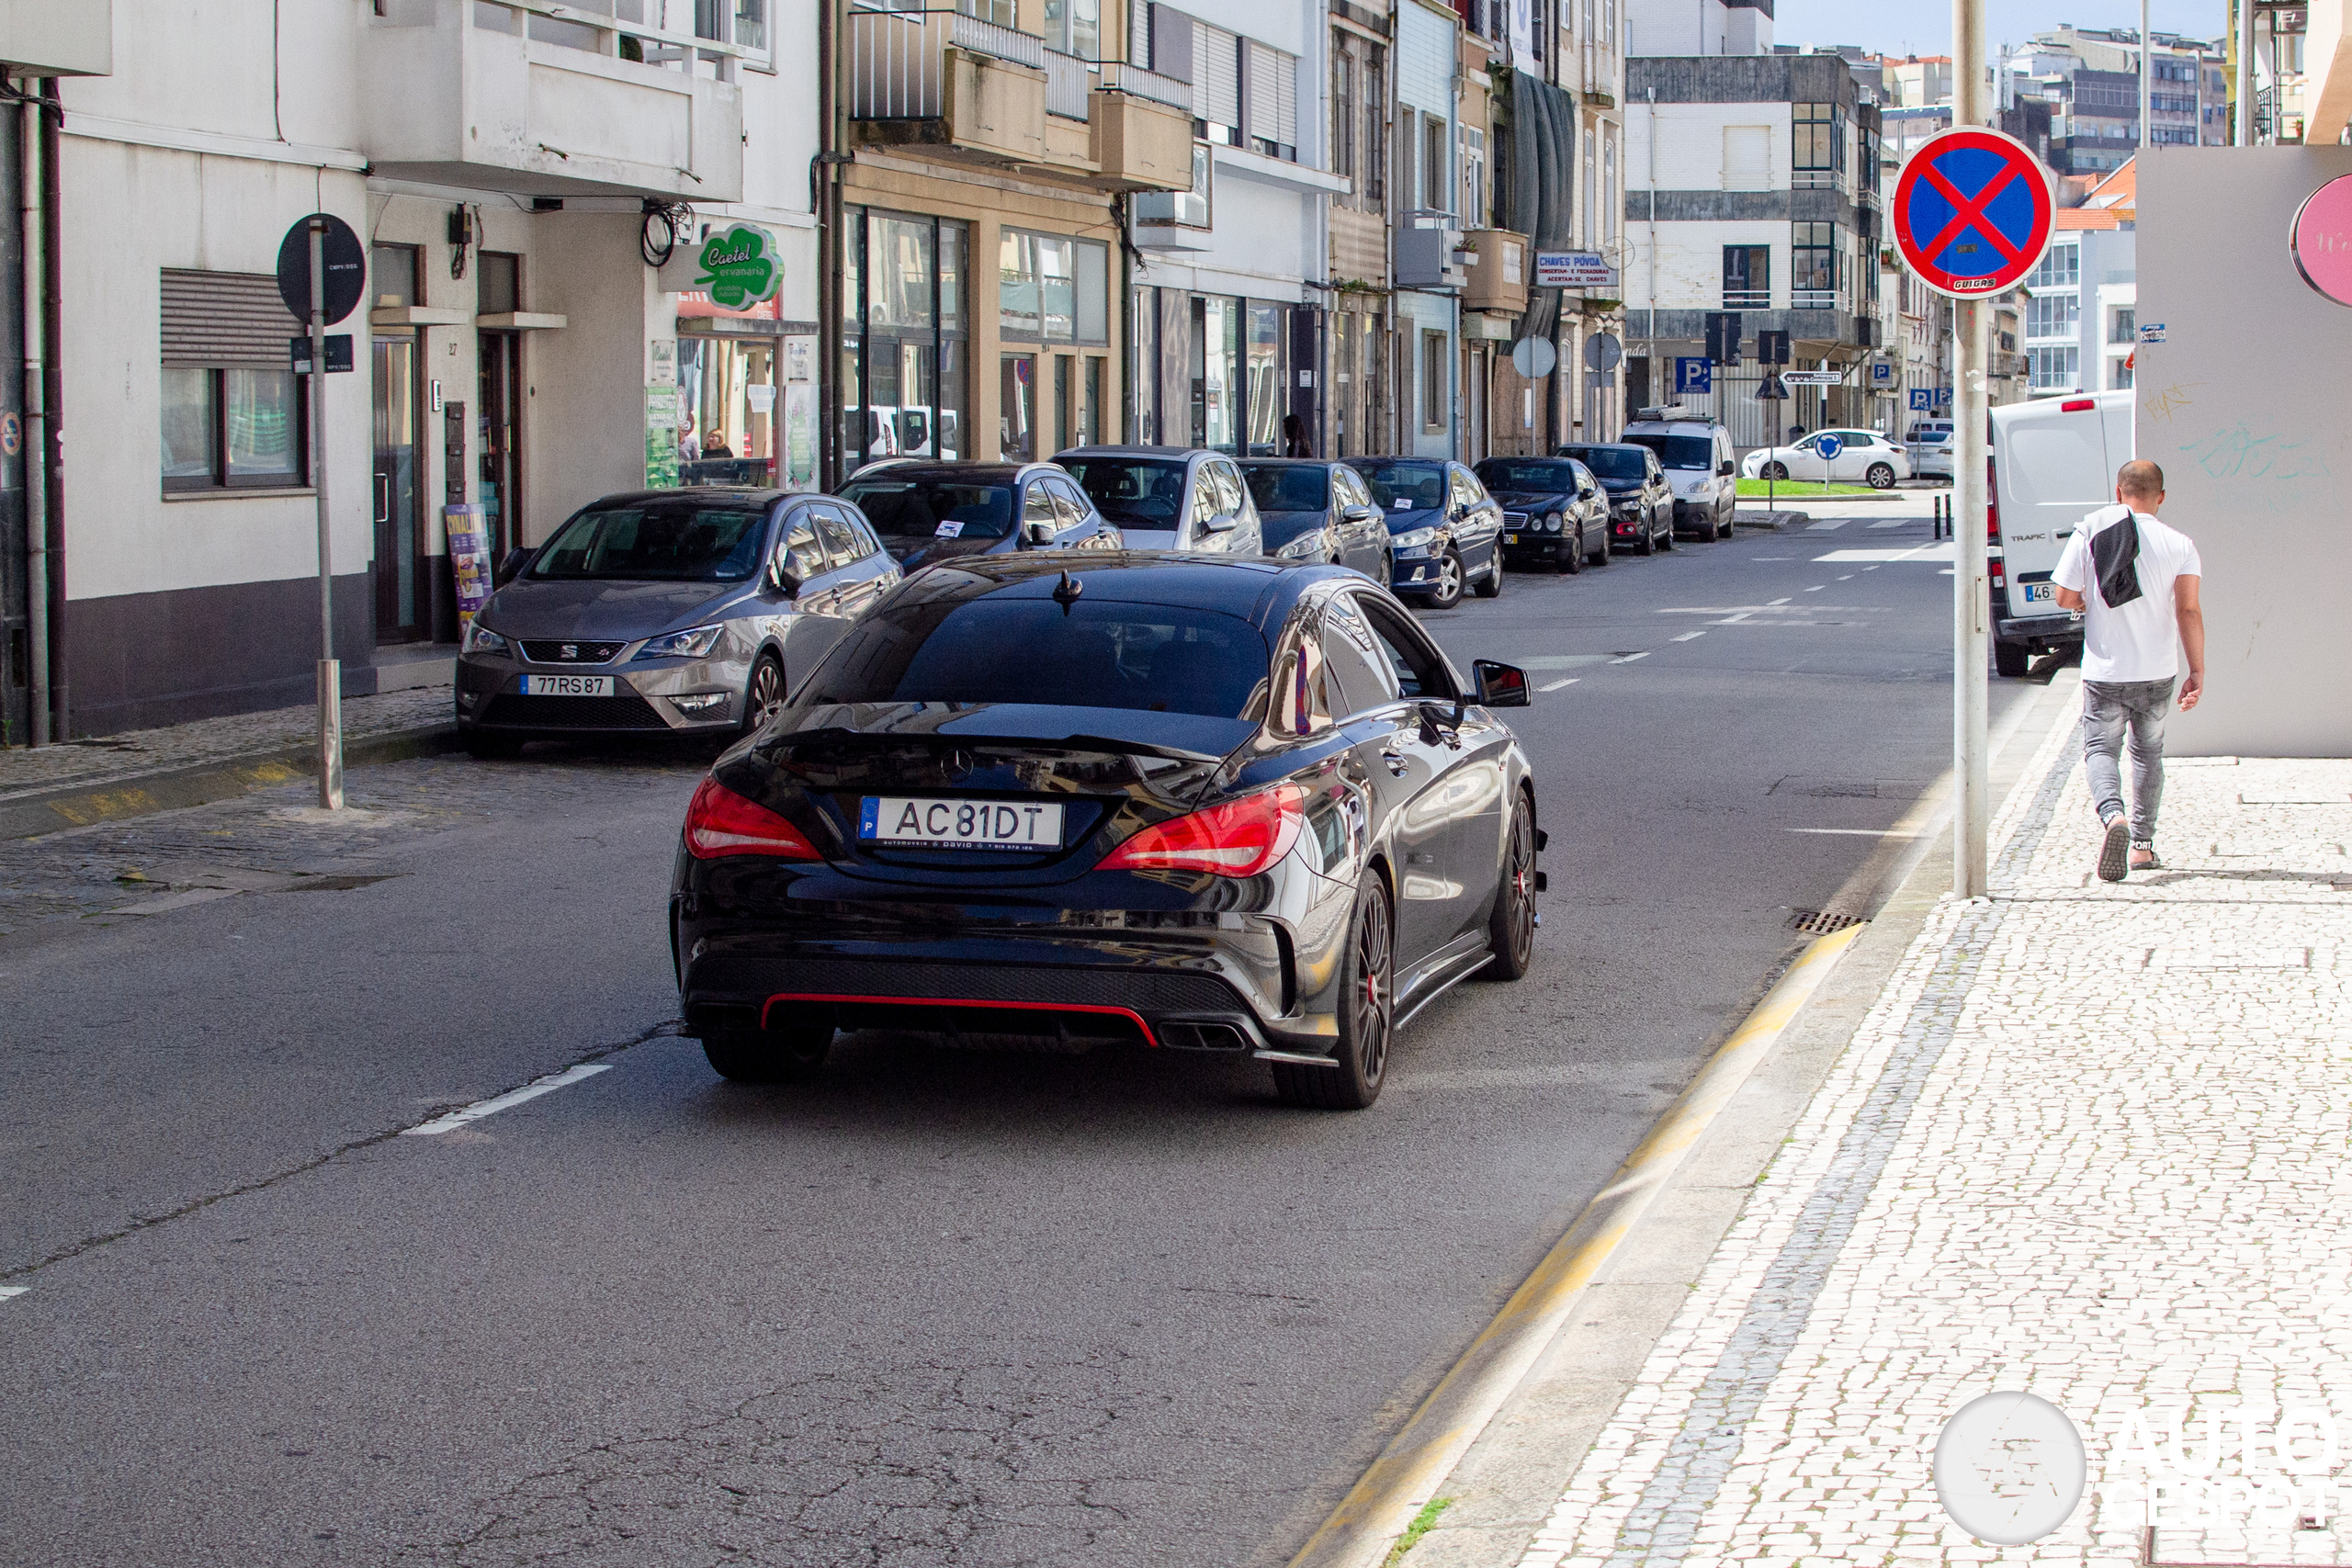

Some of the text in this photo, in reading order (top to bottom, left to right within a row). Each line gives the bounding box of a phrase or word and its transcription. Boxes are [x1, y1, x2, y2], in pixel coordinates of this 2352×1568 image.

[708, 243, 752, 266] Caetel
[1539, 255, 1600, 266] CHAVES PÓVOA
[719, 265, 765, 276] ervanaria
[1954, 278, 1996, 288] GUIGAS
[449, 343, 458, 355] 27
[1625, 343, 1647, 356] nda
[1686, 364, 1702, 385] P
[1877, 367, 1886, 378] P
[2011, 533, 2046, 542] TRAFIC
[865, 821, 874, 831] P
[2130, 840, 2152, 850] PORT
